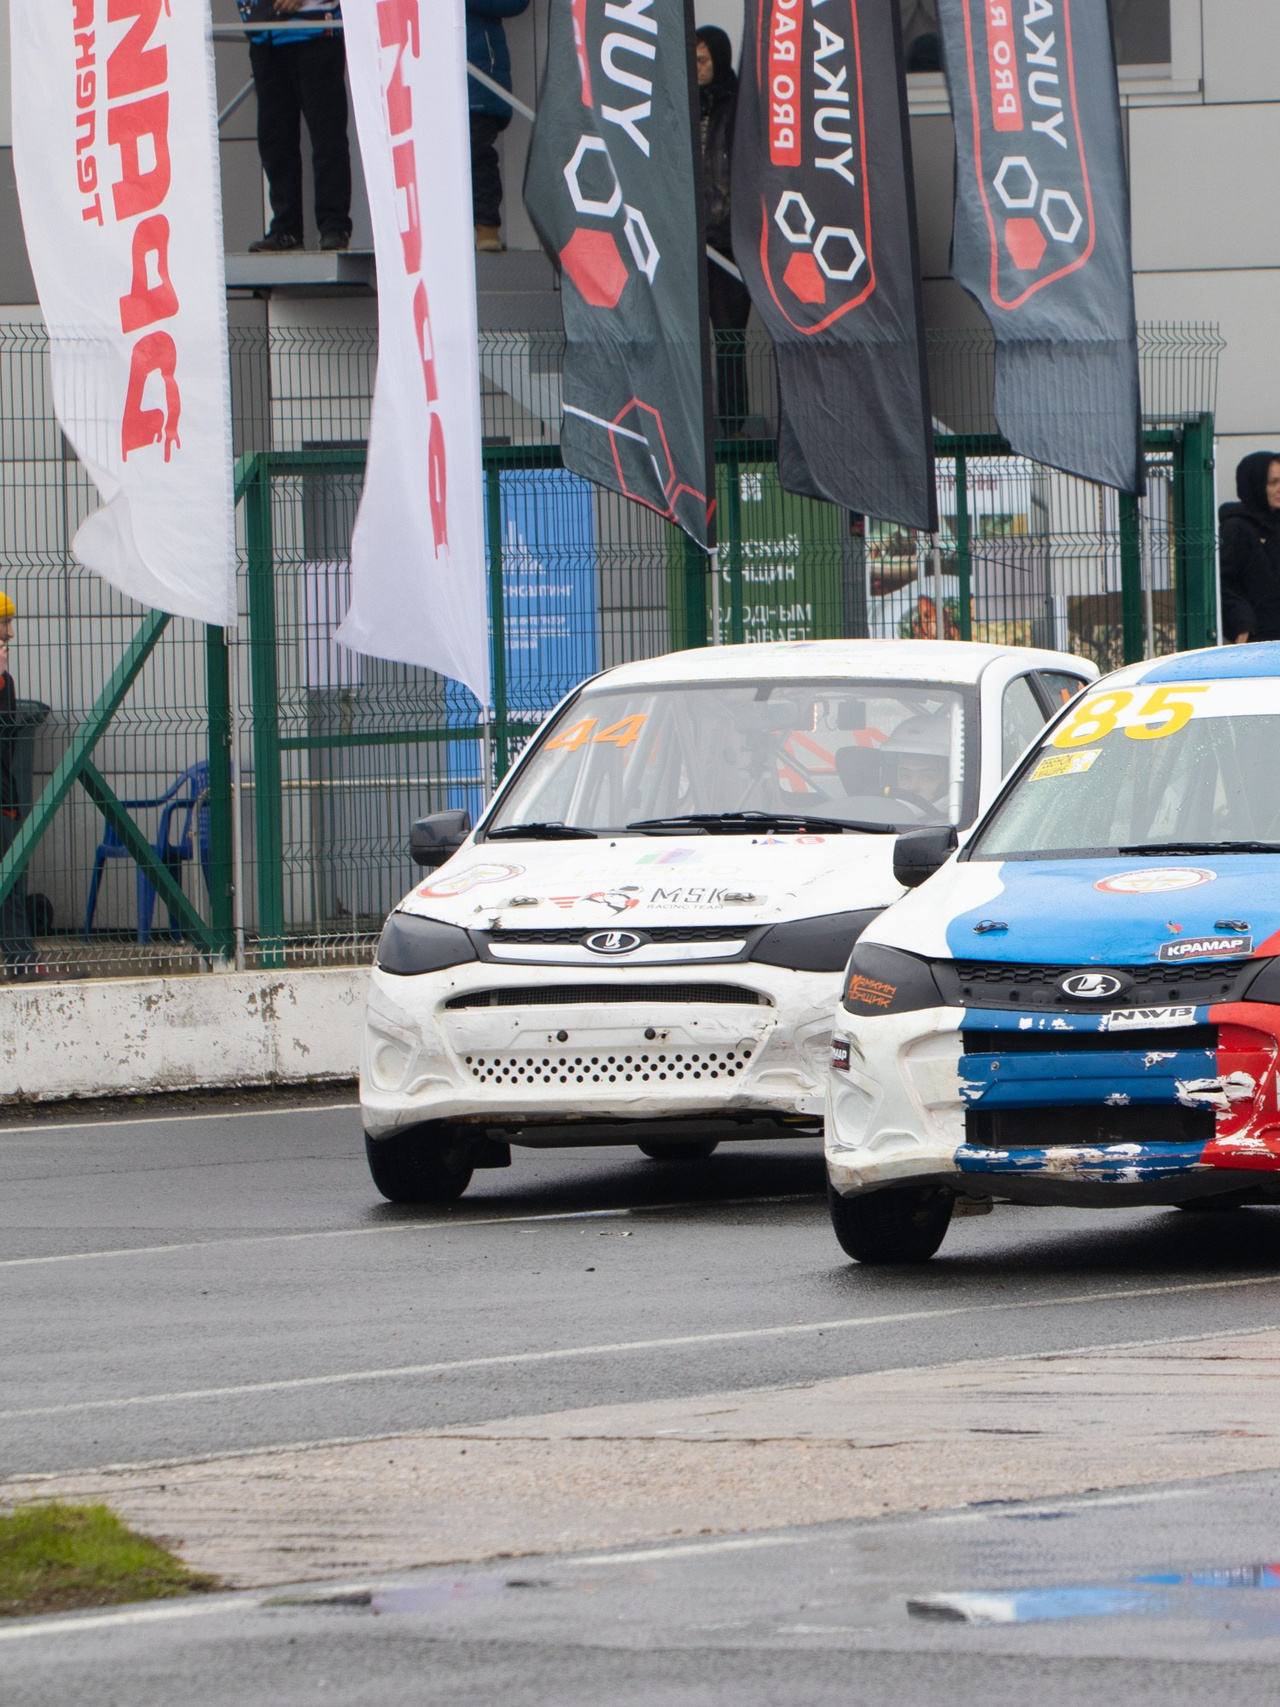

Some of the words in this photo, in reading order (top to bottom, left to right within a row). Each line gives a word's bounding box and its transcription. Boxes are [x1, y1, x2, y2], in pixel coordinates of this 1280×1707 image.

[1052, 686, 1210, 748] 85
[543, 713, 649, 752] 44
[650, 887, 730, 904] MSK
[690, 903, 725, 911] TEAM
[1168, 940, 1243, 956] КРАМАР
[1111, 1007, 1193, 1020] NWB
